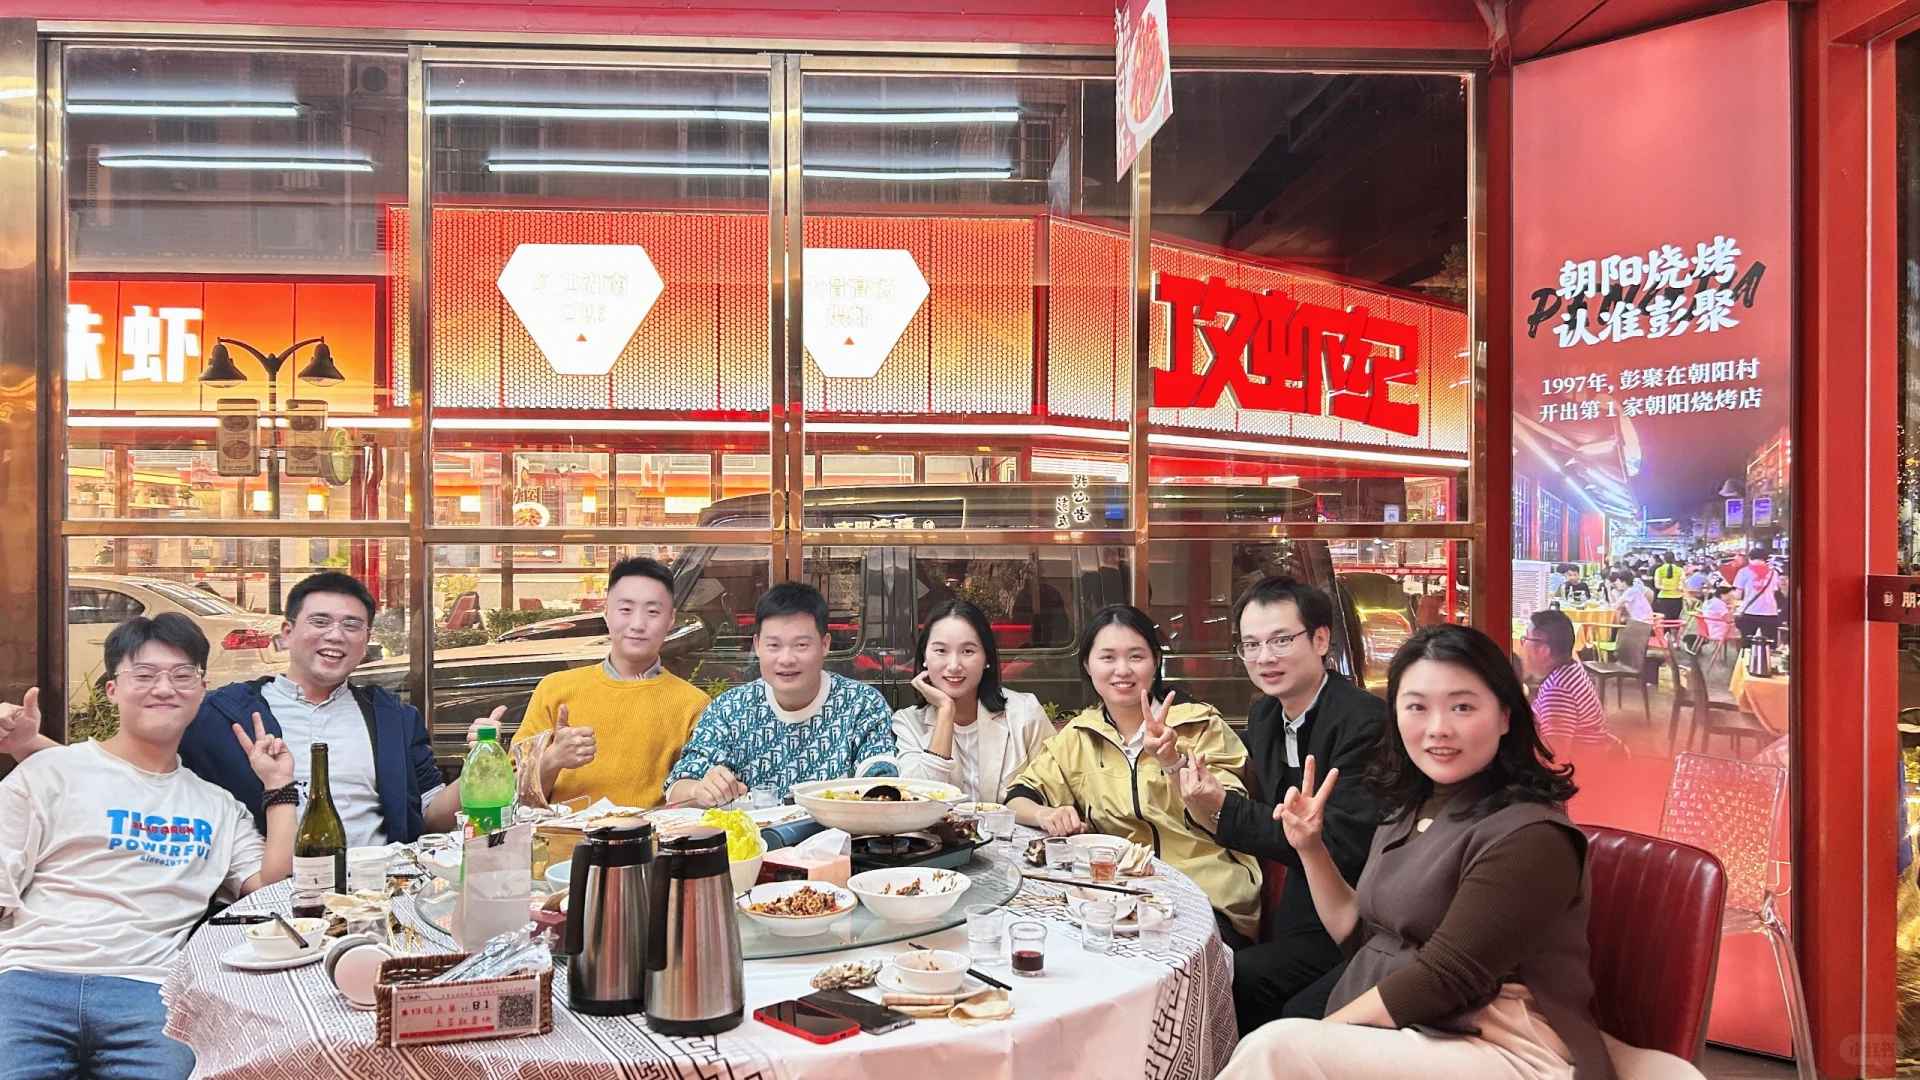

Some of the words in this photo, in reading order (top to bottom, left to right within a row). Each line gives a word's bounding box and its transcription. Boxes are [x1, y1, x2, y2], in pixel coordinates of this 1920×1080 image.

[1556, 235, 1741, 300] 朝阳烧烤
[1553, 288, 1740, 348] 认准彭聚
[1151, 271, 1420, 437] 攻虾记
[1901, 592, 1920, 608] 朋
[107, 809, 212, 846] TIGER
[108, 838, 210, 861] POWERFUL
[472, 1000, 489, 1010] B1
